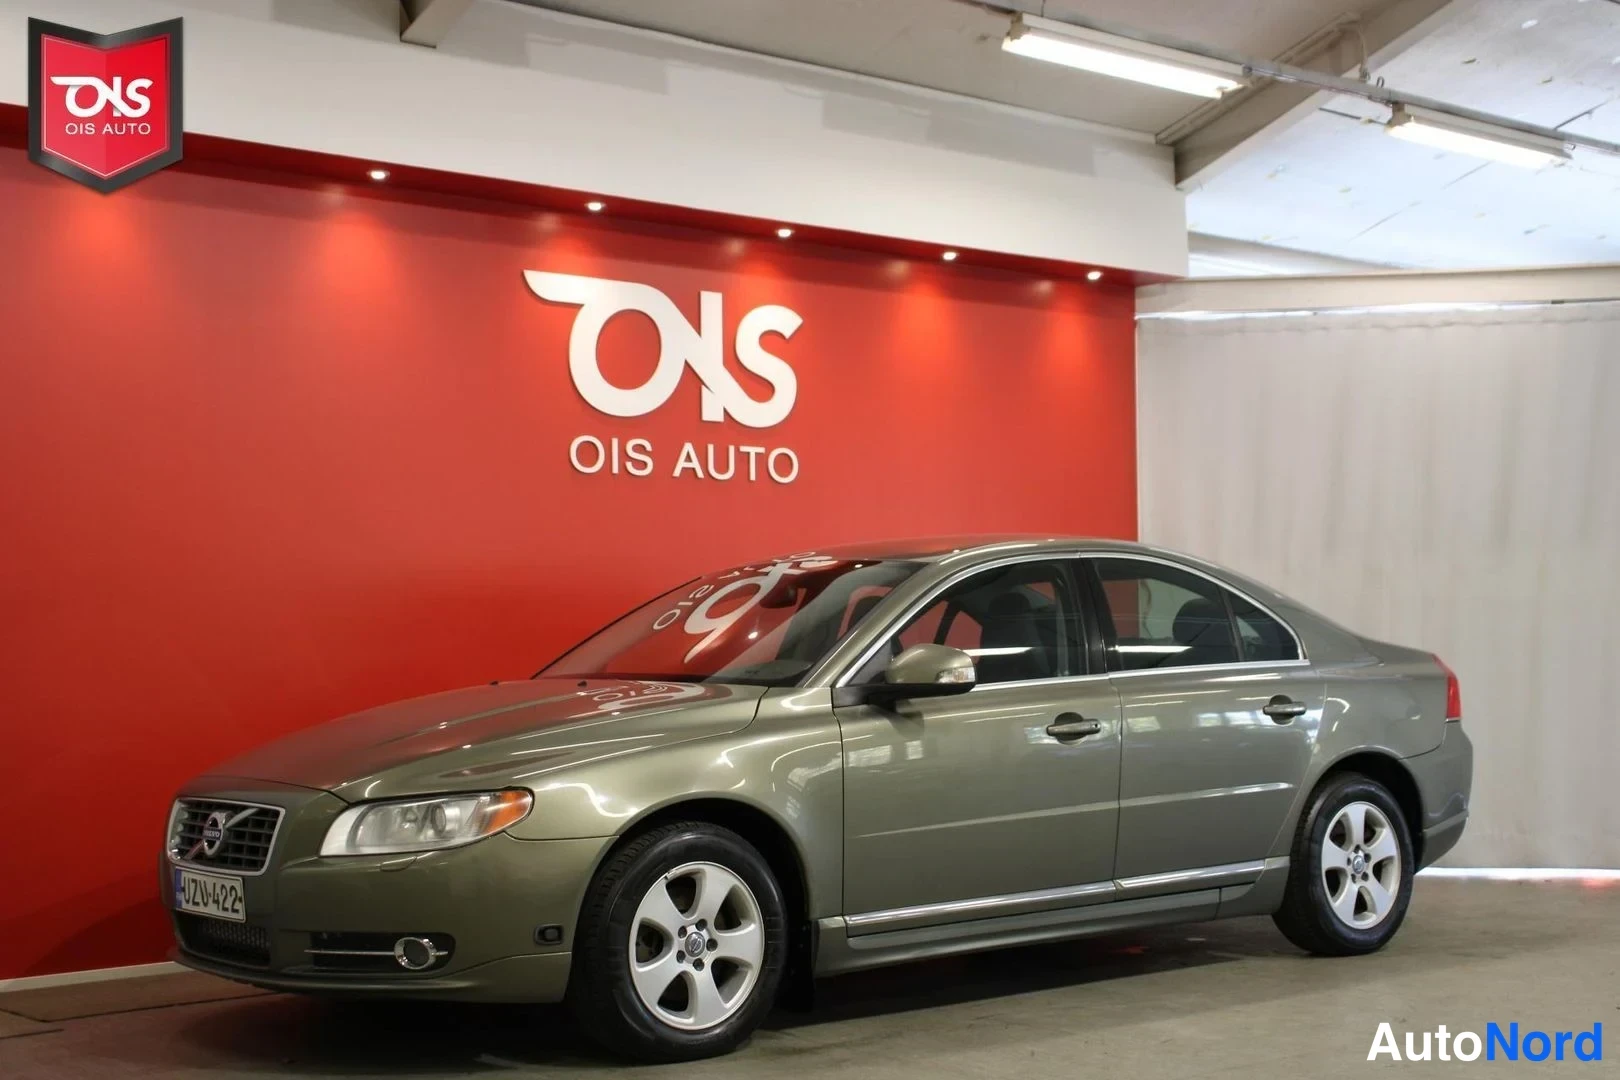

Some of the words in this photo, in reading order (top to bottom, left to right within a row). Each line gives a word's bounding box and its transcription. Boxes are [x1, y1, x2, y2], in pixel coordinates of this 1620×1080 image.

[523, 269, 804, 428] OIS
[569, 435, 654, 476] OIS
[672, 442, 799, 484] AUTO
